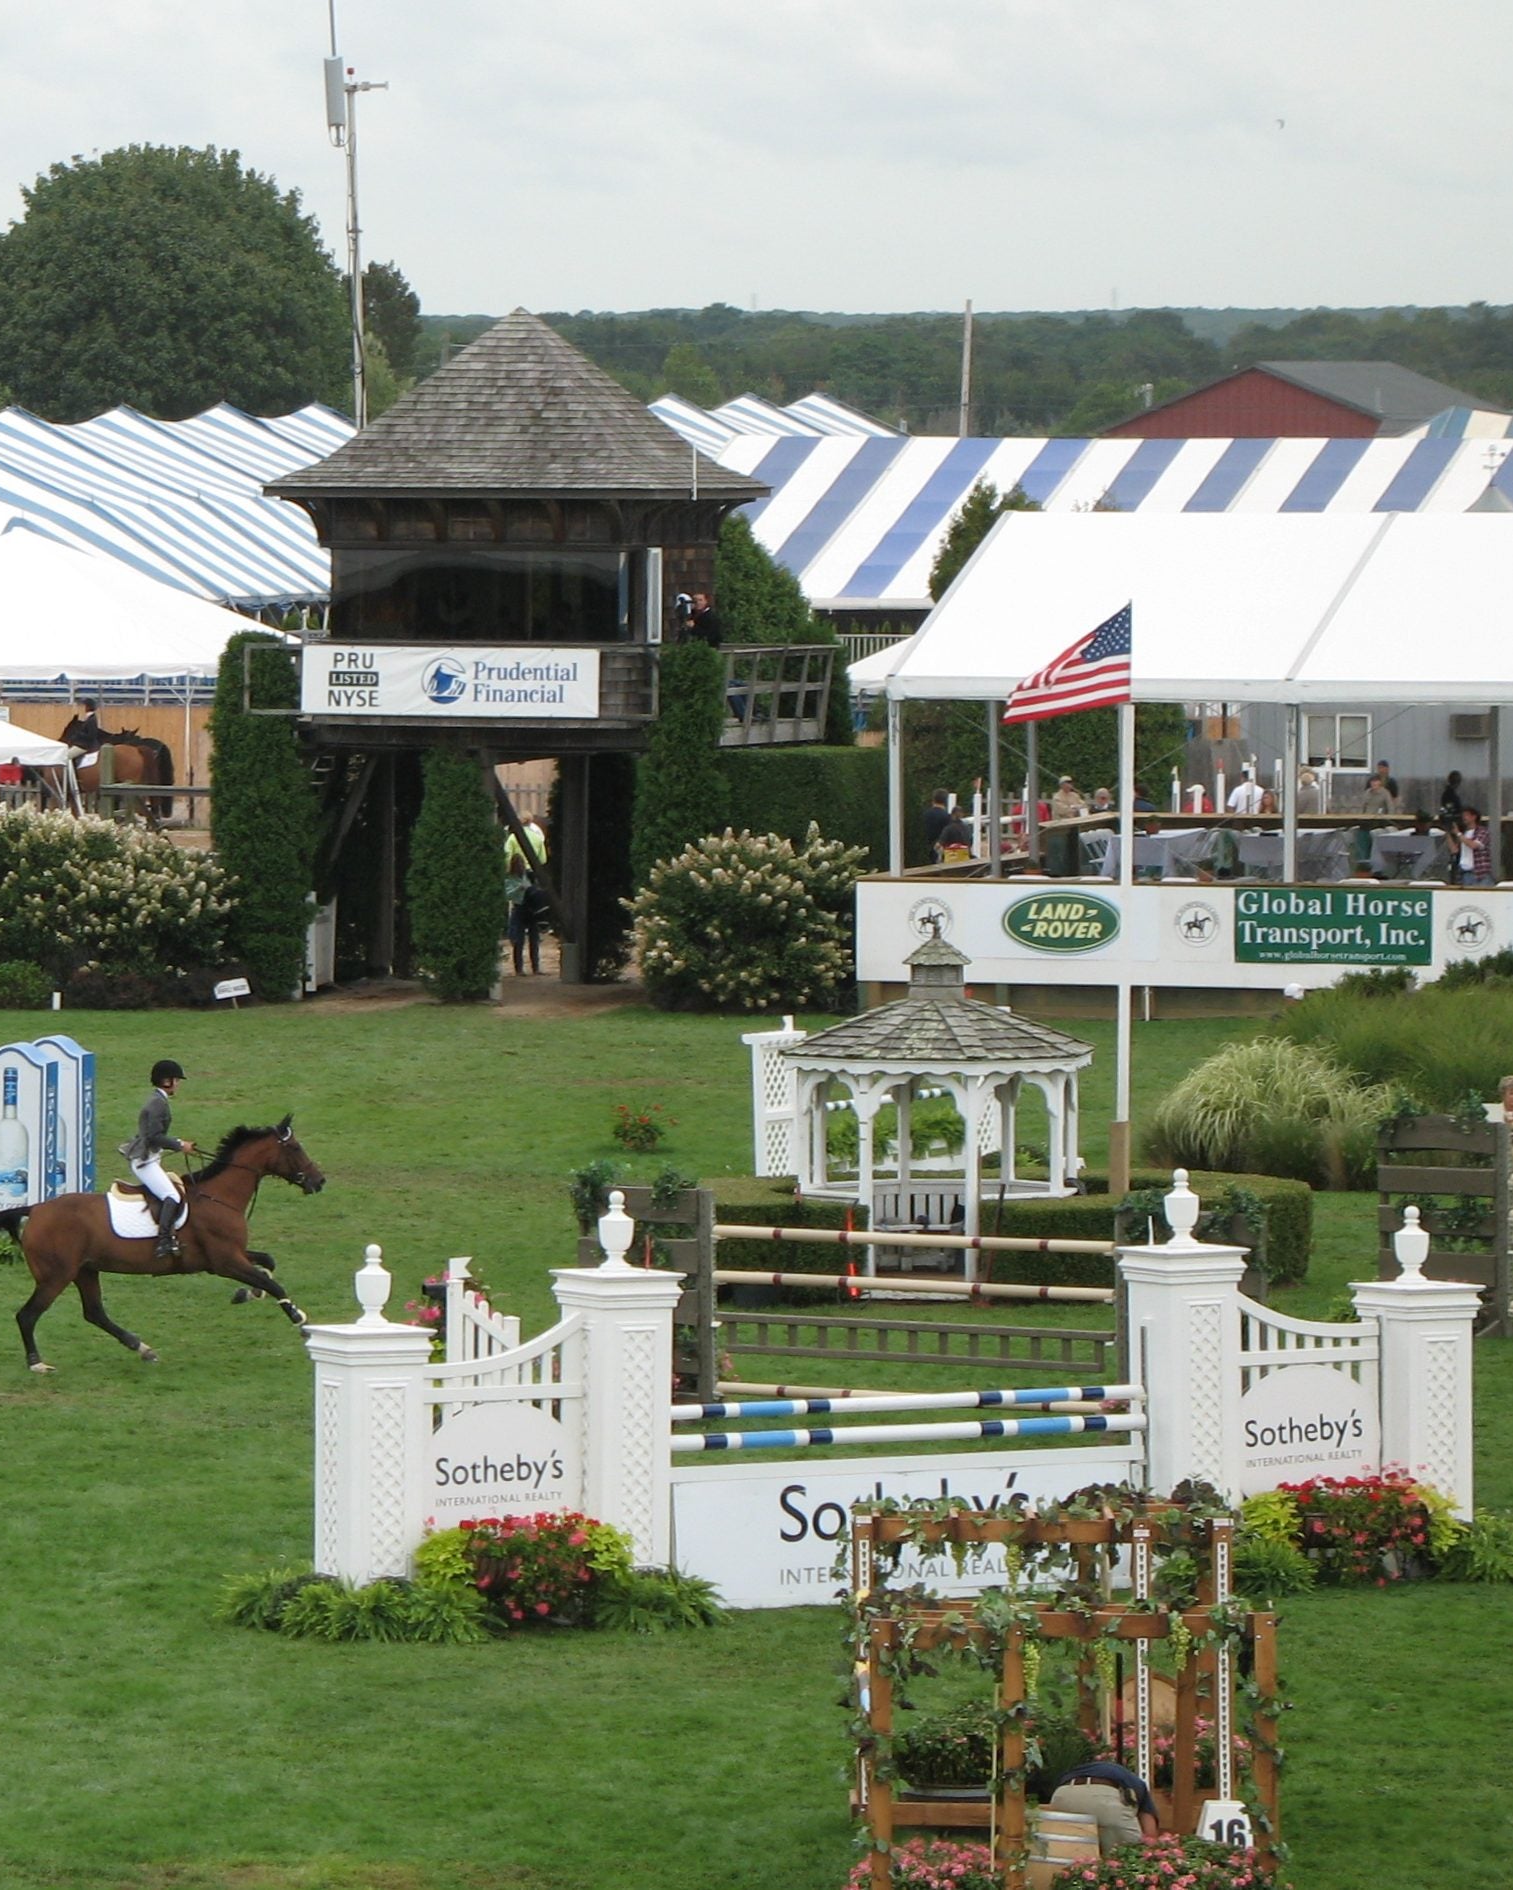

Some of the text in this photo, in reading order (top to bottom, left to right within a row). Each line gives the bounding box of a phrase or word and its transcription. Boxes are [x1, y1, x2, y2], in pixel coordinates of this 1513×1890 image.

[333, 652, 374, 669] PRU
[332, 672, 377, 685] LISTED
[473, 661, 578, 681] Prudential
[327, 689, 380, 707] NYSE
[473, 683, 564, 703] Financial
[1027, 903, 1085, 919] LAND
[1238, 891, 1428, 916] Global Horse
[1032, 921, 1102, 938] ROVER
[1238, 920, 1372, 949] Transport,
[1379, 923, 1426, 946] Inc.
[1245, 1408, 1363, 1448] Sotheby's
[1246, 1450, 1363, 1468] INTERNATIONAL REALTY
[435, 1449, 563, 1489] Sotheby's
[435, 1491, 562, 1507] INTERNATIONAL REALTY
[1209, 1818, 1246, 1850] 16
